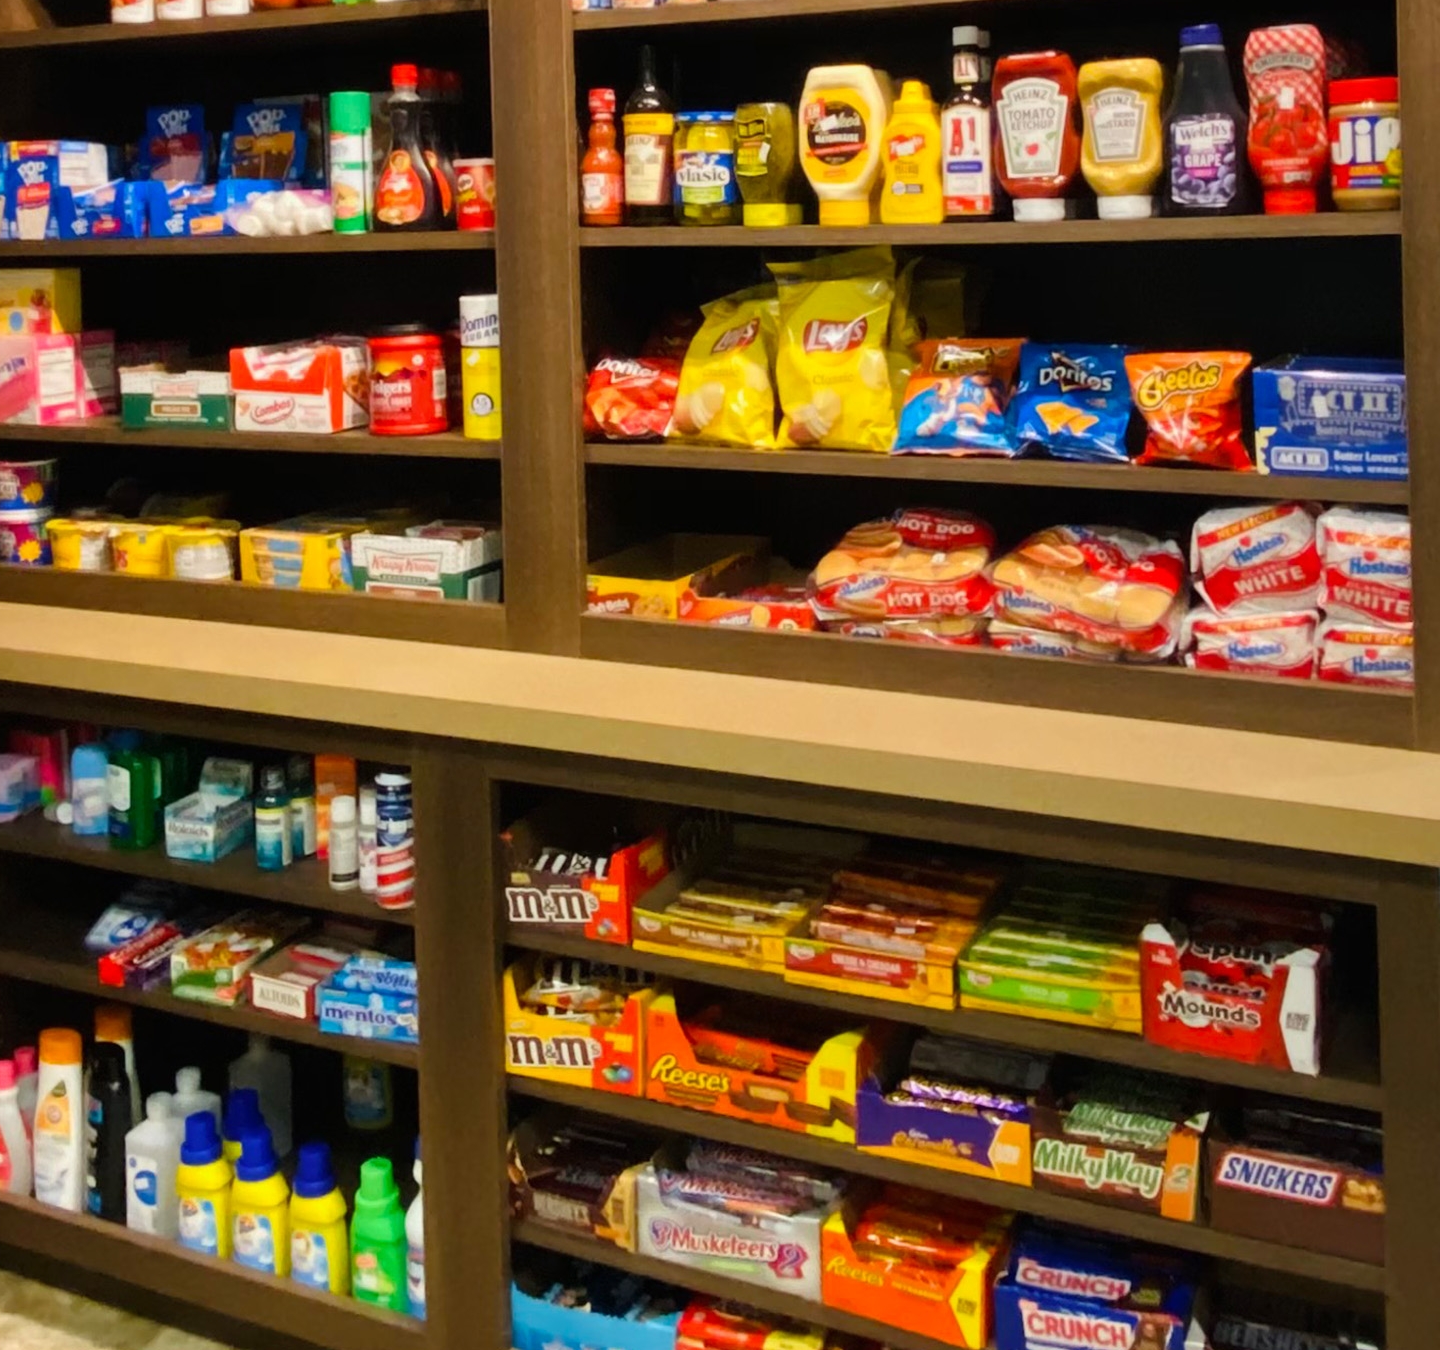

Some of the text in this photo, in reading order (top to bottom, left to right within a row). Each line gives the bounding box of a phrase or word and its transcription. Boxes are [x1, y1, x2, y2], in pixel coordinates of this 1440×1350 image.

[1013, 89, 1049, 101] HEINZ
[1100, 96, 1130, 107] HEINZ
[1008, 107, 1055, 122] TOMATO
[1011, 119, 1054, 131] KETCHUP
[1179, 121, 1228, 142] Welch's
[1184, 152, 1222, 168] GRAPE
[461, 314, 498, 334] Domin
[715, 320, 758, 353] Lay's
[806, 319, 867, 352] Lay's
[1039, 364, 1113, 394] Doritos
[1137, 361, 1222, 411] Cheetos
[936, 521, 975, 535] DOG
[1231, 532, 1286, 566] Hostess
[1348, 555, 1410, 577] Hostess
[1234, 564, 1307, 594] WHITE
[888, 591, 968, 607] HOT DOG
[1002, 589, 1054, 614] Hostess
[1333, 586, 1410, 616] WHITE
[1227, 642, 1284, 659] Hostess
[1352, 656, 1410, 677] Hostess
[324, 1004, 398, 1026] mentos
[1162, 993, 1261, 1027] Mounds
[651, 1054, 731, 1093] Reese's
[1223, 1157, 1335, 1201] SNICKERS
[672, 1226, 779, 1262] Musketeers
[1021, 1265, 1126, 1298] CRUNCH
[1026, 1311, 1128, 1348] CRUNCH
